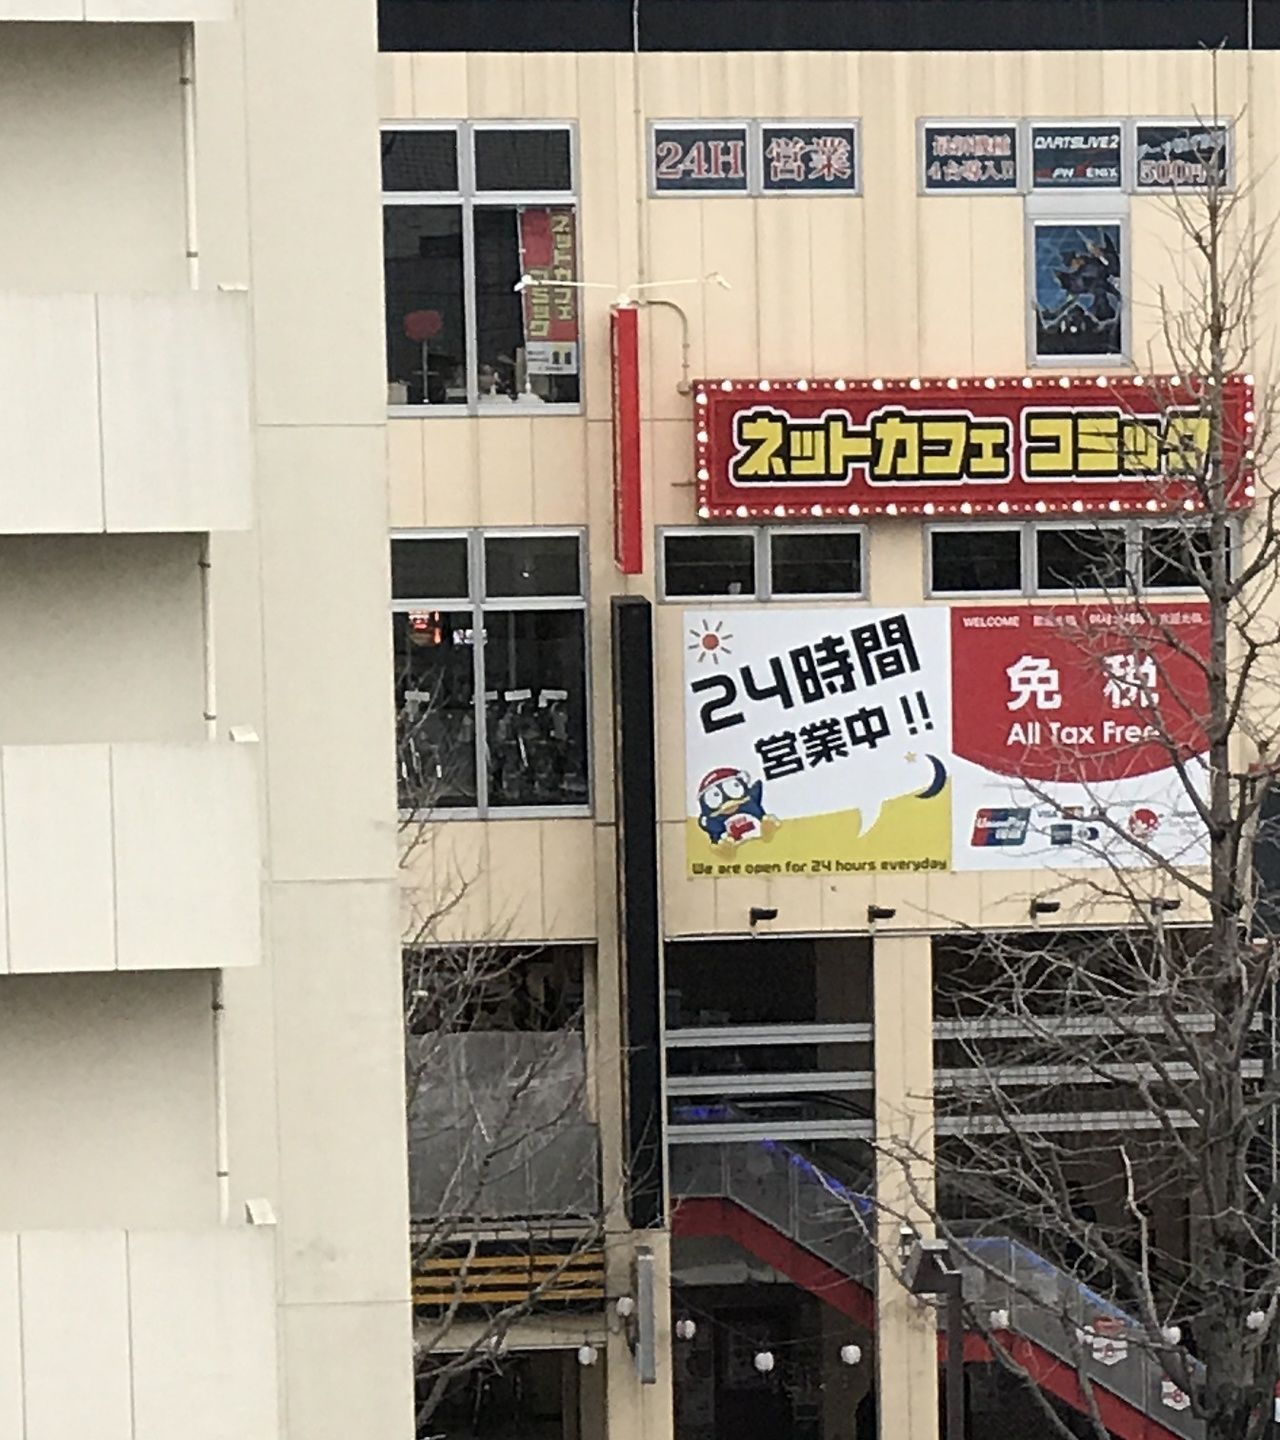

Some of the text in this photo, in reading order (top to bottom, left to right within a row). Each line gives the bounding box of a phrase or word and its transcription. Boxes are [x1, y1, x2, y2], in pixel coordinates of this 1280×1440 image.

[656, 136, 851, 181] 24H 営業
[738, 416, 1210, 476] ネットカフェ コミック
[963, 616, 1020, 628] WELCOME
[691, 613, 921, 734] 24時間
[1007, 719, 1160, 746] All Tax Free
[692, 857, 948, 876] We are open for 24 hours everyday
